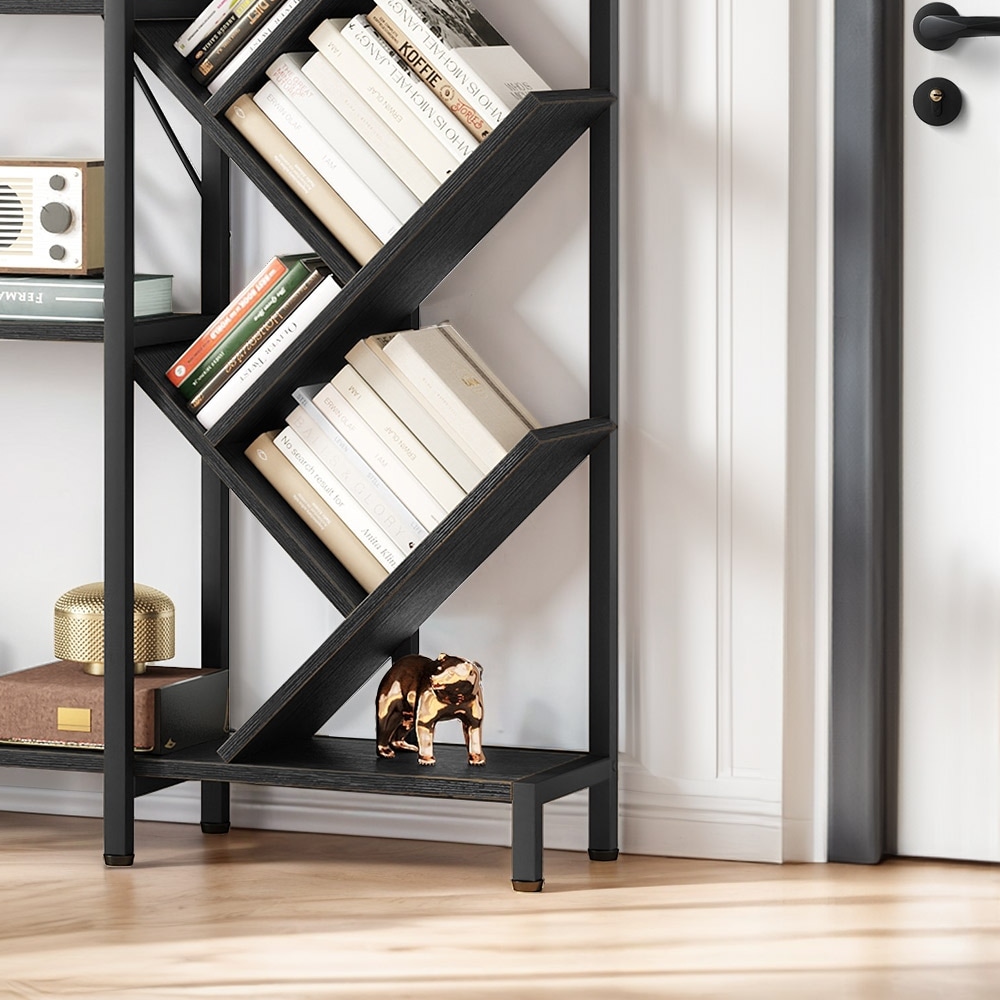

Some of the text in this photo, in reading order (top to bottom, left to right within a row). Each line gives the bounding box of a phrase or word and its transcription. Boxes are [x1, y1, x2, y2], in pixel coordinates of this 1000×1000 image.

[200, 31, 219, 53] SAIKIA
[215, 13, 235, 36] ANKUSH
[352, 27, 392, 69] JANG?
[419, 31, 471, 86] MICHAEL
[279, 62, 314, 100] THE GREAT
[385, 63, 437, 119] MICHAEL
[396, 39, 486, 135] KOFFIE STORIES
[463, 80, 481, 97] IS
[265, 92, 289, 117] ERWIN
[283, 112, 303, 132] OLAF
[366, 83, 404, 123] ERWIN OLAF
[474, 91, 506, 124] WHO
[430, 113, 448, 131] IS
[236, 286, 258, 310] BOOK
[253, 271, 273, 293] BEST
[207, 314, 231, 341] WORLD
[262, 317, 299, 359] OLIVER
[236, 352, 268, 388] TWIST
[322, 396, 357, 433] ERWIN OLAF
[383, 424, 417, 461] ERWIN OLAF
[278, 434, 295, 451] No
[289, 446, 318, 476] search
[312, 471, 336, 496] result
[330, 491, 347, 508] for
[359, 524, 384, 551] Anita
